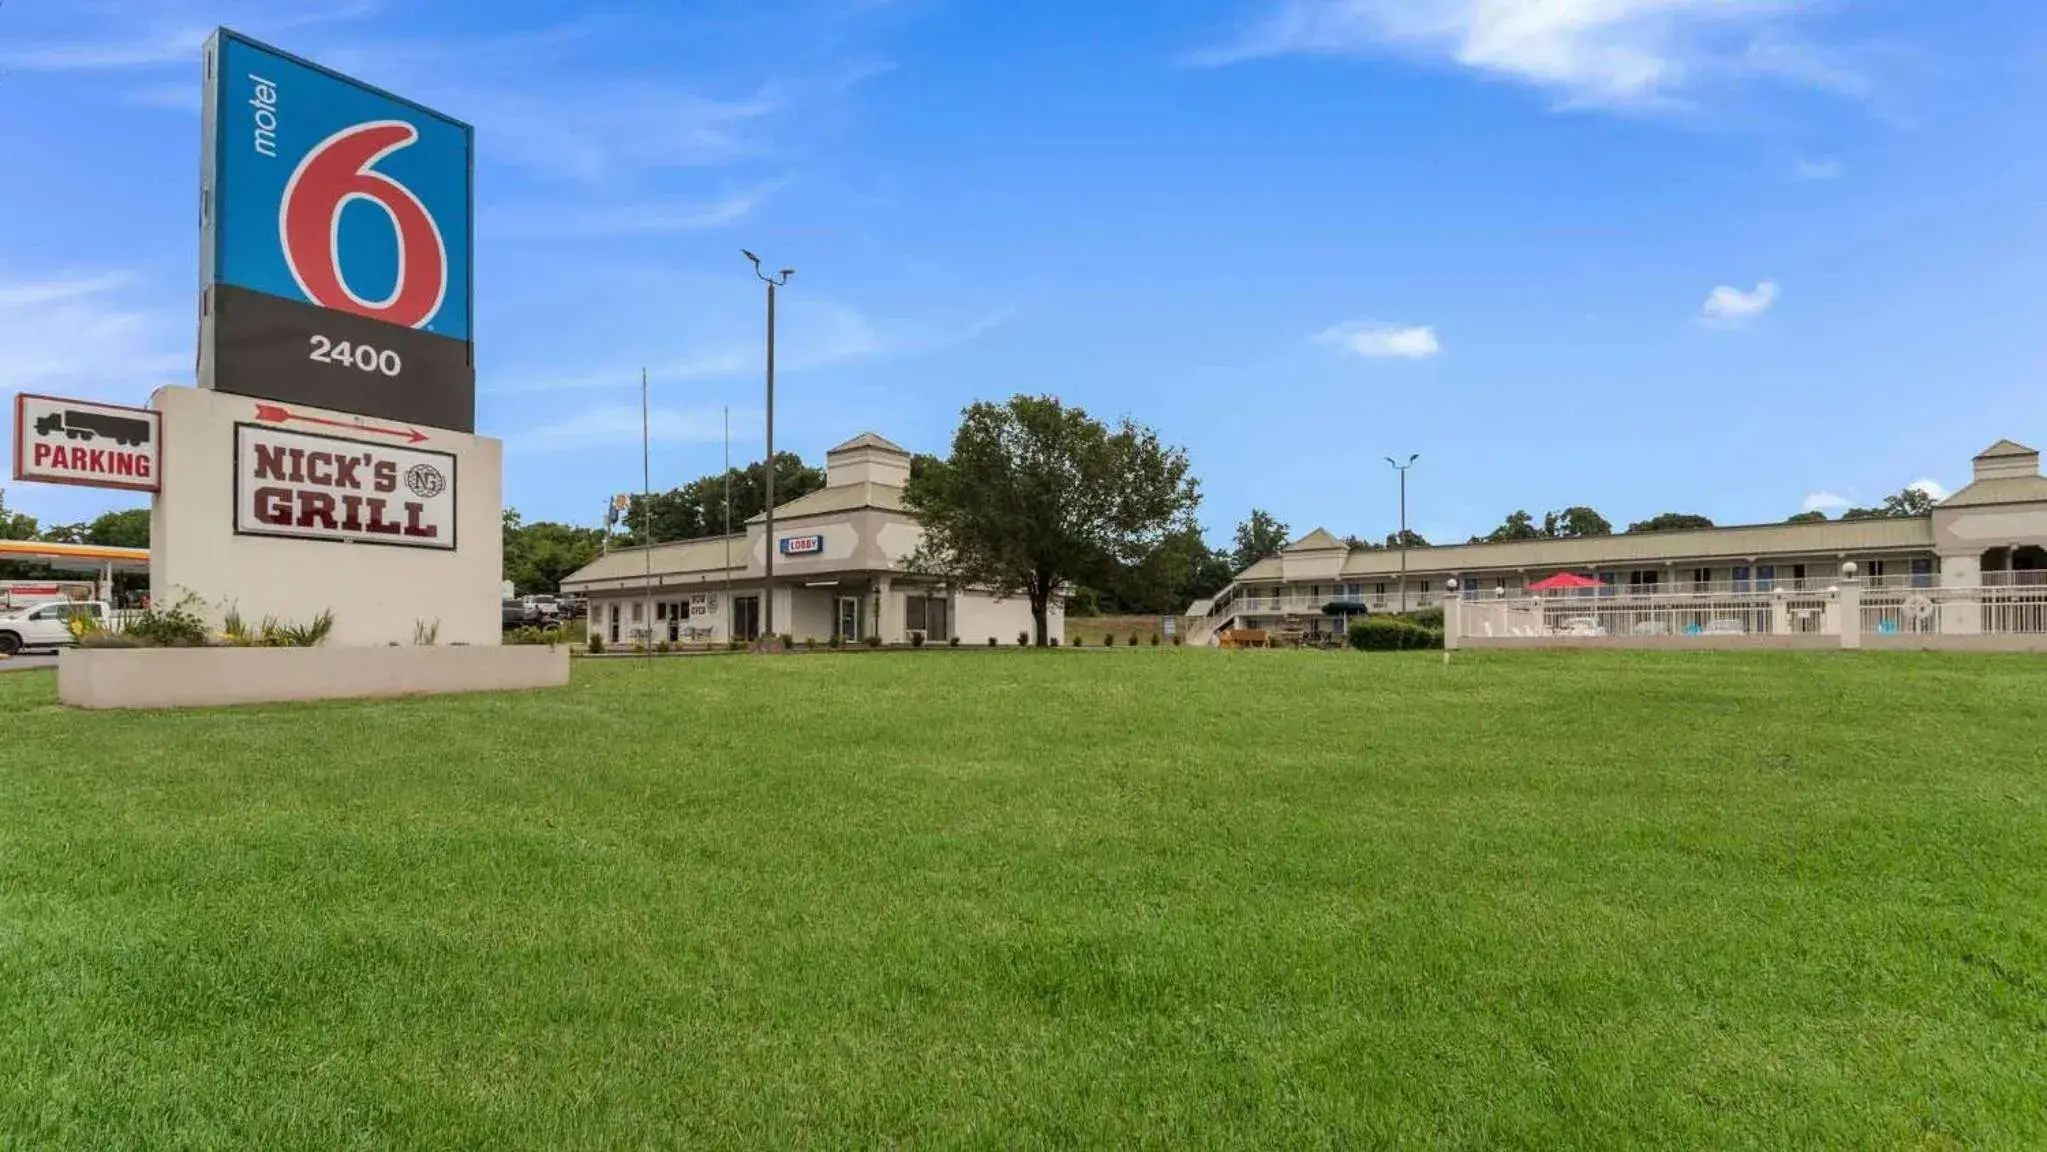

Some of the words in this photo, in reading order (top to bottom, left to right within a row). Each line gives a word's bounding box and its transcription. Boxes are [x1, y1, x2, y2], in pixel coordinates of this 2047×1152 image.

[248, 73, 277, 157] motel
[279, 119, 448, 329] 6
[309, 334, 402, 376] 2400
[34, 442, 151, 477] PARKING
[254, 443, 397, 492] NICK'S
[253, 486, 438, 537] GRILL
[790, 539, 817, 550] LOBBY
